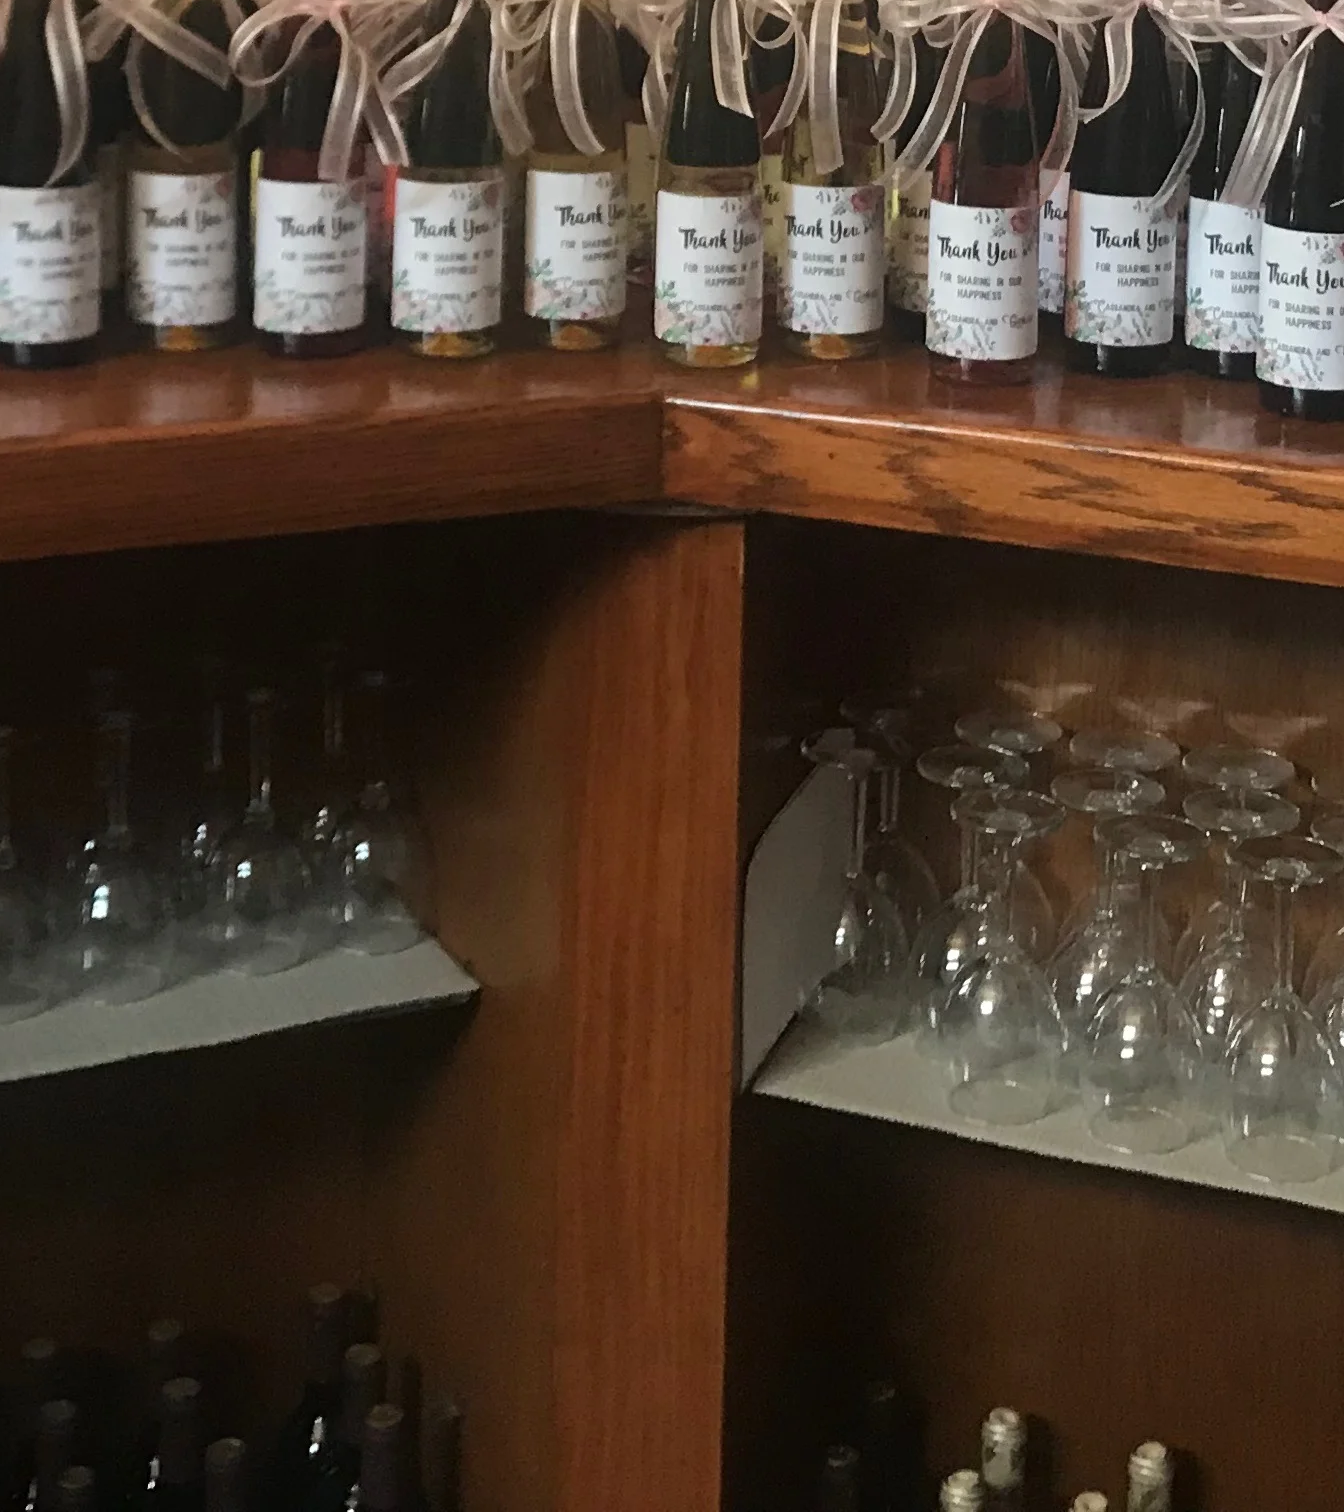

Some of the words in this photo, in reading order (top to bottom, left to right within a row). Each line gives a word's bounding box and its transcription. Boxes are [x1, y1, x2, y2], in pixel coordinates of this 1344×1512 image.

[140, 207, 188, 228] Thank
[554, 203, 604, 226] Thank
[12, 220, 63, 244] Thank
[275, 215, 326, 238] Thank
[331, 216, 356, 241] You
[409, 216, 457, 238] Thank
[463, 217, 489, 242] You
[678, 227, 727, 250] Thank
[784, 215, 823, 239] Thank
[830, 220, 860, 244] You
[1090, 226, 1142, 249] Thank
[937, 234, 981, 260] Thank
[987, 241, 1017, 267] You
[1204, 232, 1256, 256] Thank
[1096, 261, 1111, 273] FOR
[1210, 268, 1225, 280] FOR
[1266, 261, 1309, 289] Thank
[1285, 302, 1320, 316] SHARING
[1285, 317, 1332, 330] HAPPINESS
